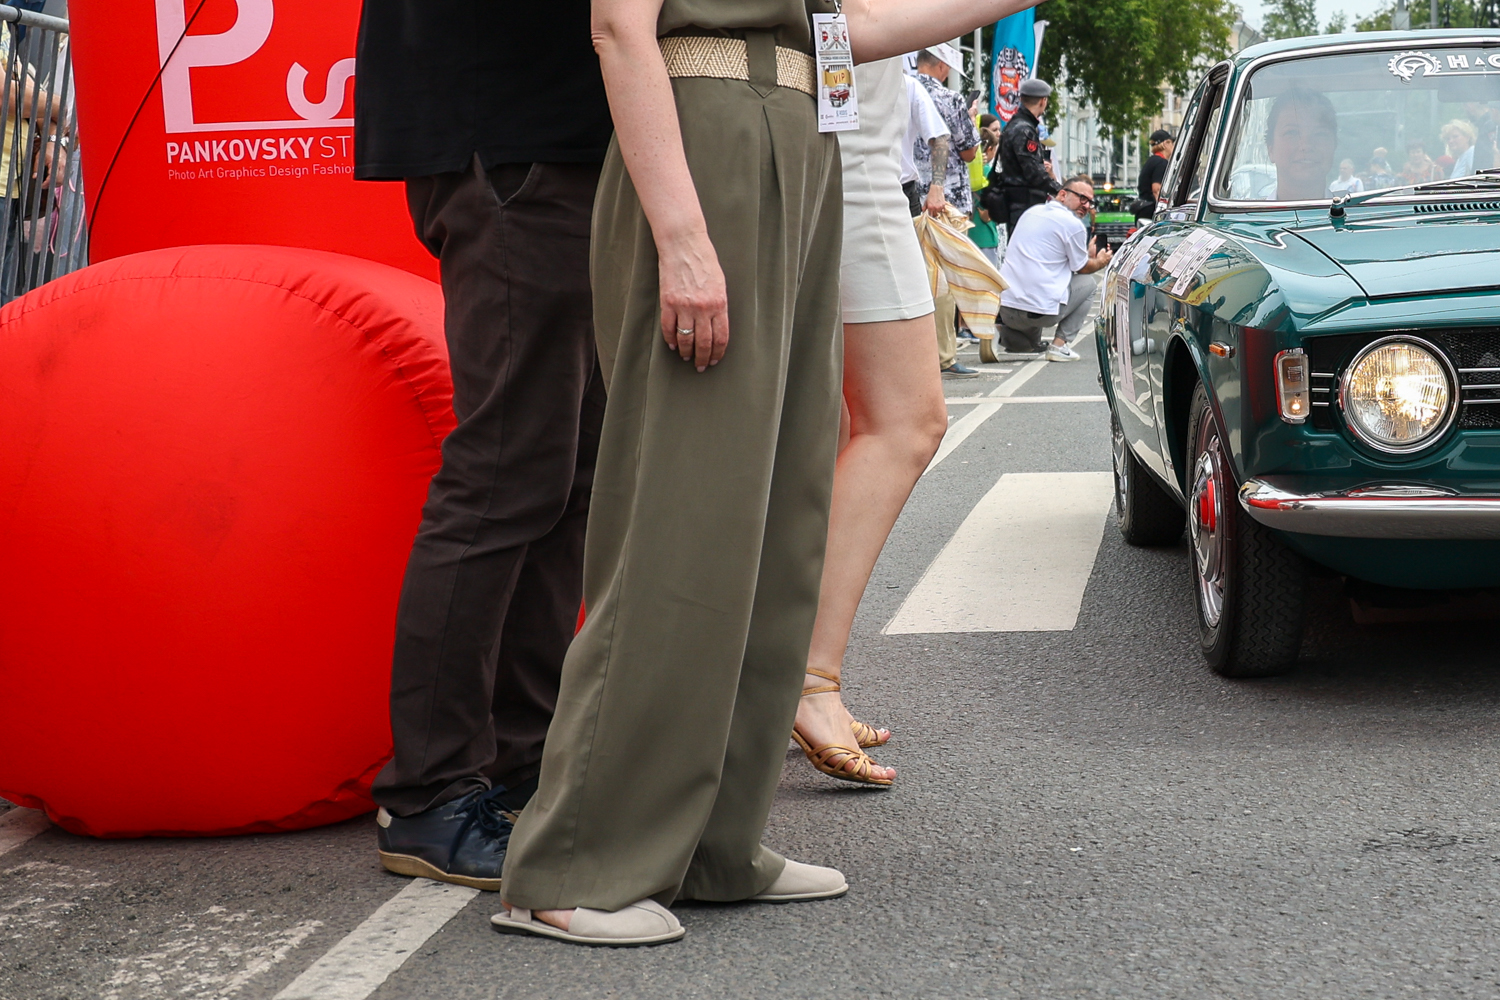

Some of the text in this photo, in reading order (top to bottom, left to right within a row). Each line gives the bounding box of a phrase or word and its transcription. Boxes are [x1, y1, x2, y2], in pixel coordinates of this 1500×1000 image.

[833, 72, 846, 84] VIP
[165, 135, 352, 164] PANKOVSKY ST
[168, 163, 355, 180] Photo Art Graphics Design Fashio
